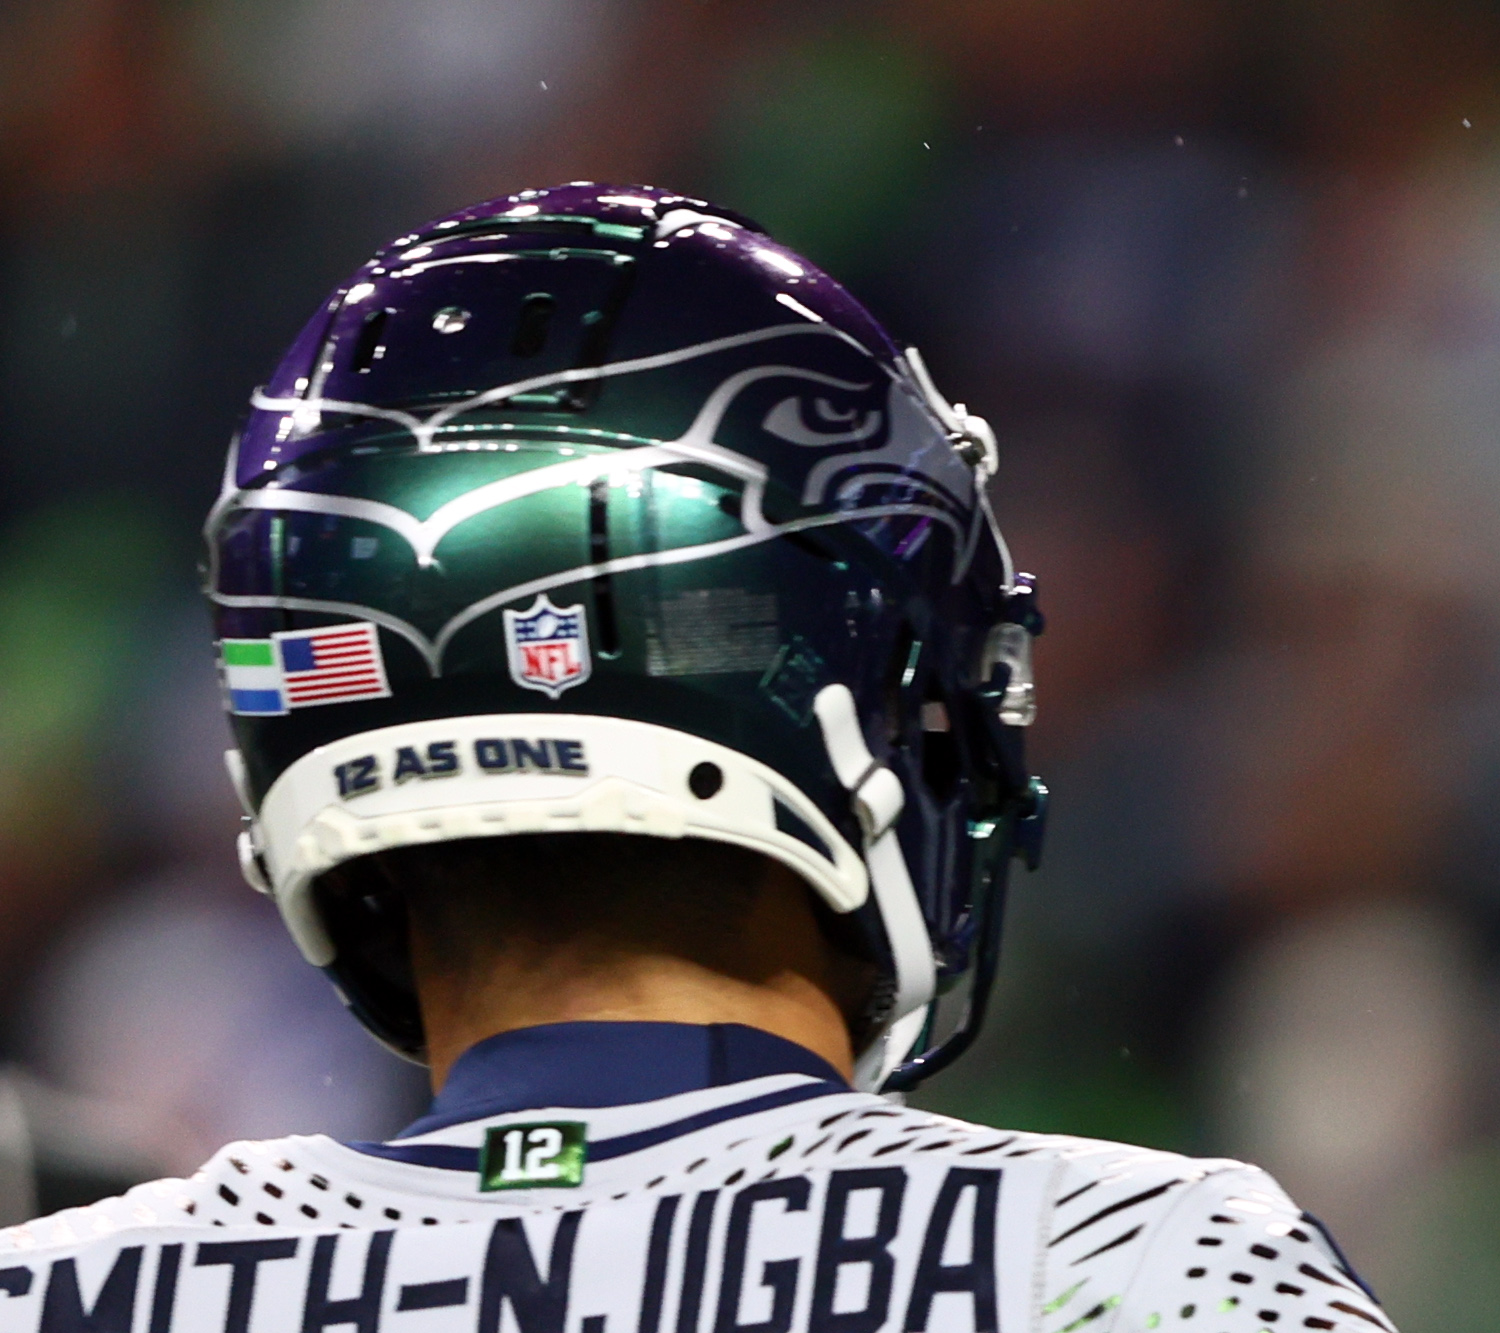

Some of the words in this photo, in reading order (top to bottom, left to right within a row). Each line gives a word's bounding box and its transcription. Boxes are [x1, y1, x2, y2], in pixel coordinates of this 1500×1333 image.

[518, 643, 582, 681] NFL
[333, 755, 380, 801] 12
[393, 741, 461, 786] AS
[473, 738, 589, 778] ONE
[501, 1128, 564, 1181] 12
